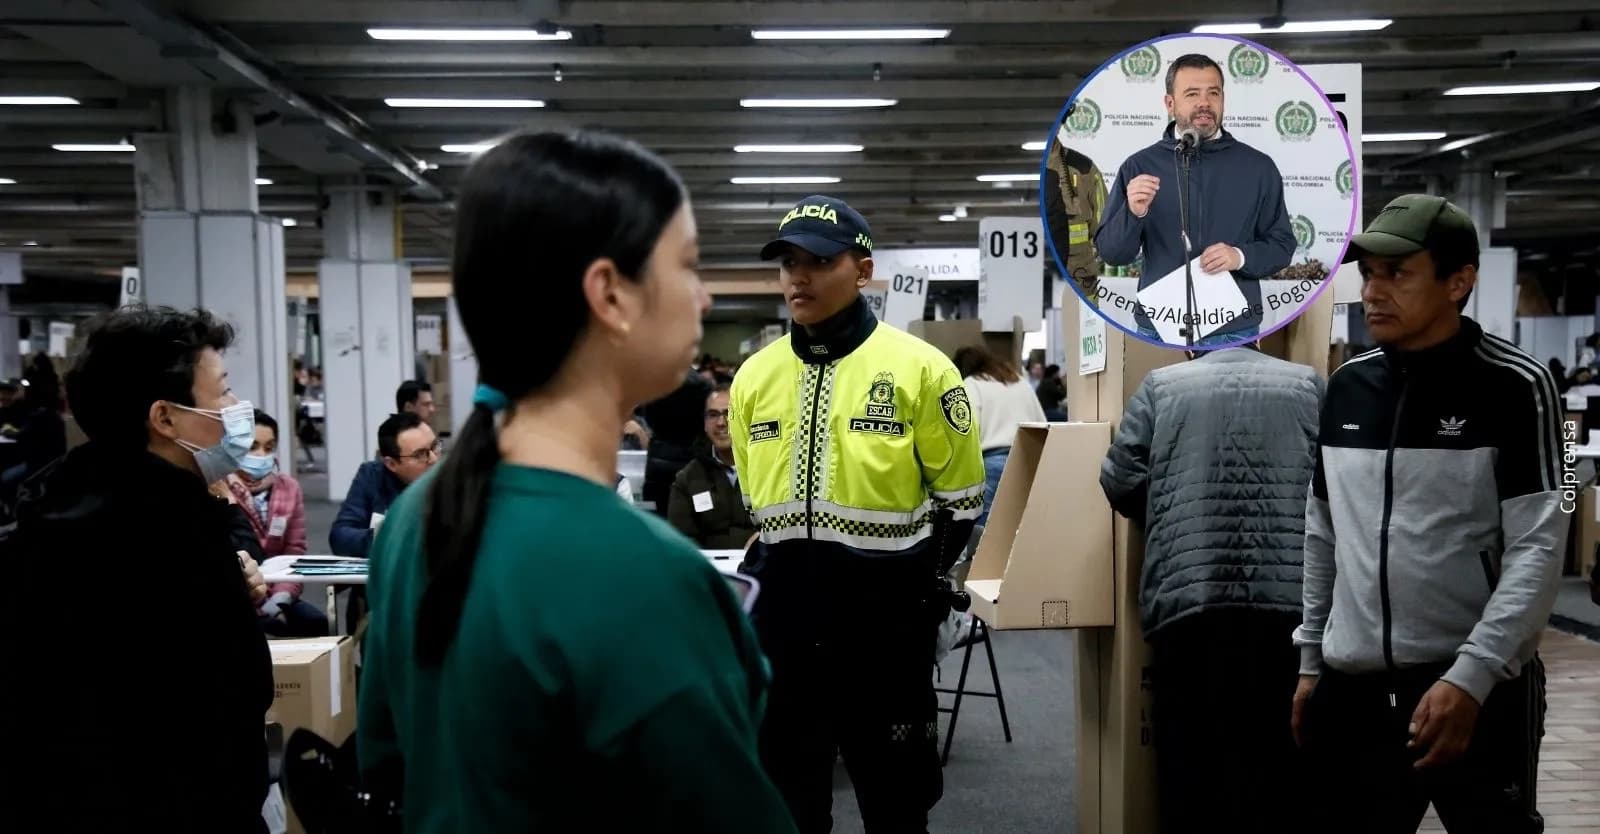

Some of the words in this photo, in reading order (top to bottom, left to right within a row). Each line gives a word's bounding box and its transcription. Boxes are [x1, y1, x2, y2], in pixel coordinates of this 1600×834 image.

[990, 230, 1038, 258] 013
[893, 273, 924, 296] 021
[1082, 335, 1098, 357] MESA
[868, 405, 893, 417] ESCAR
